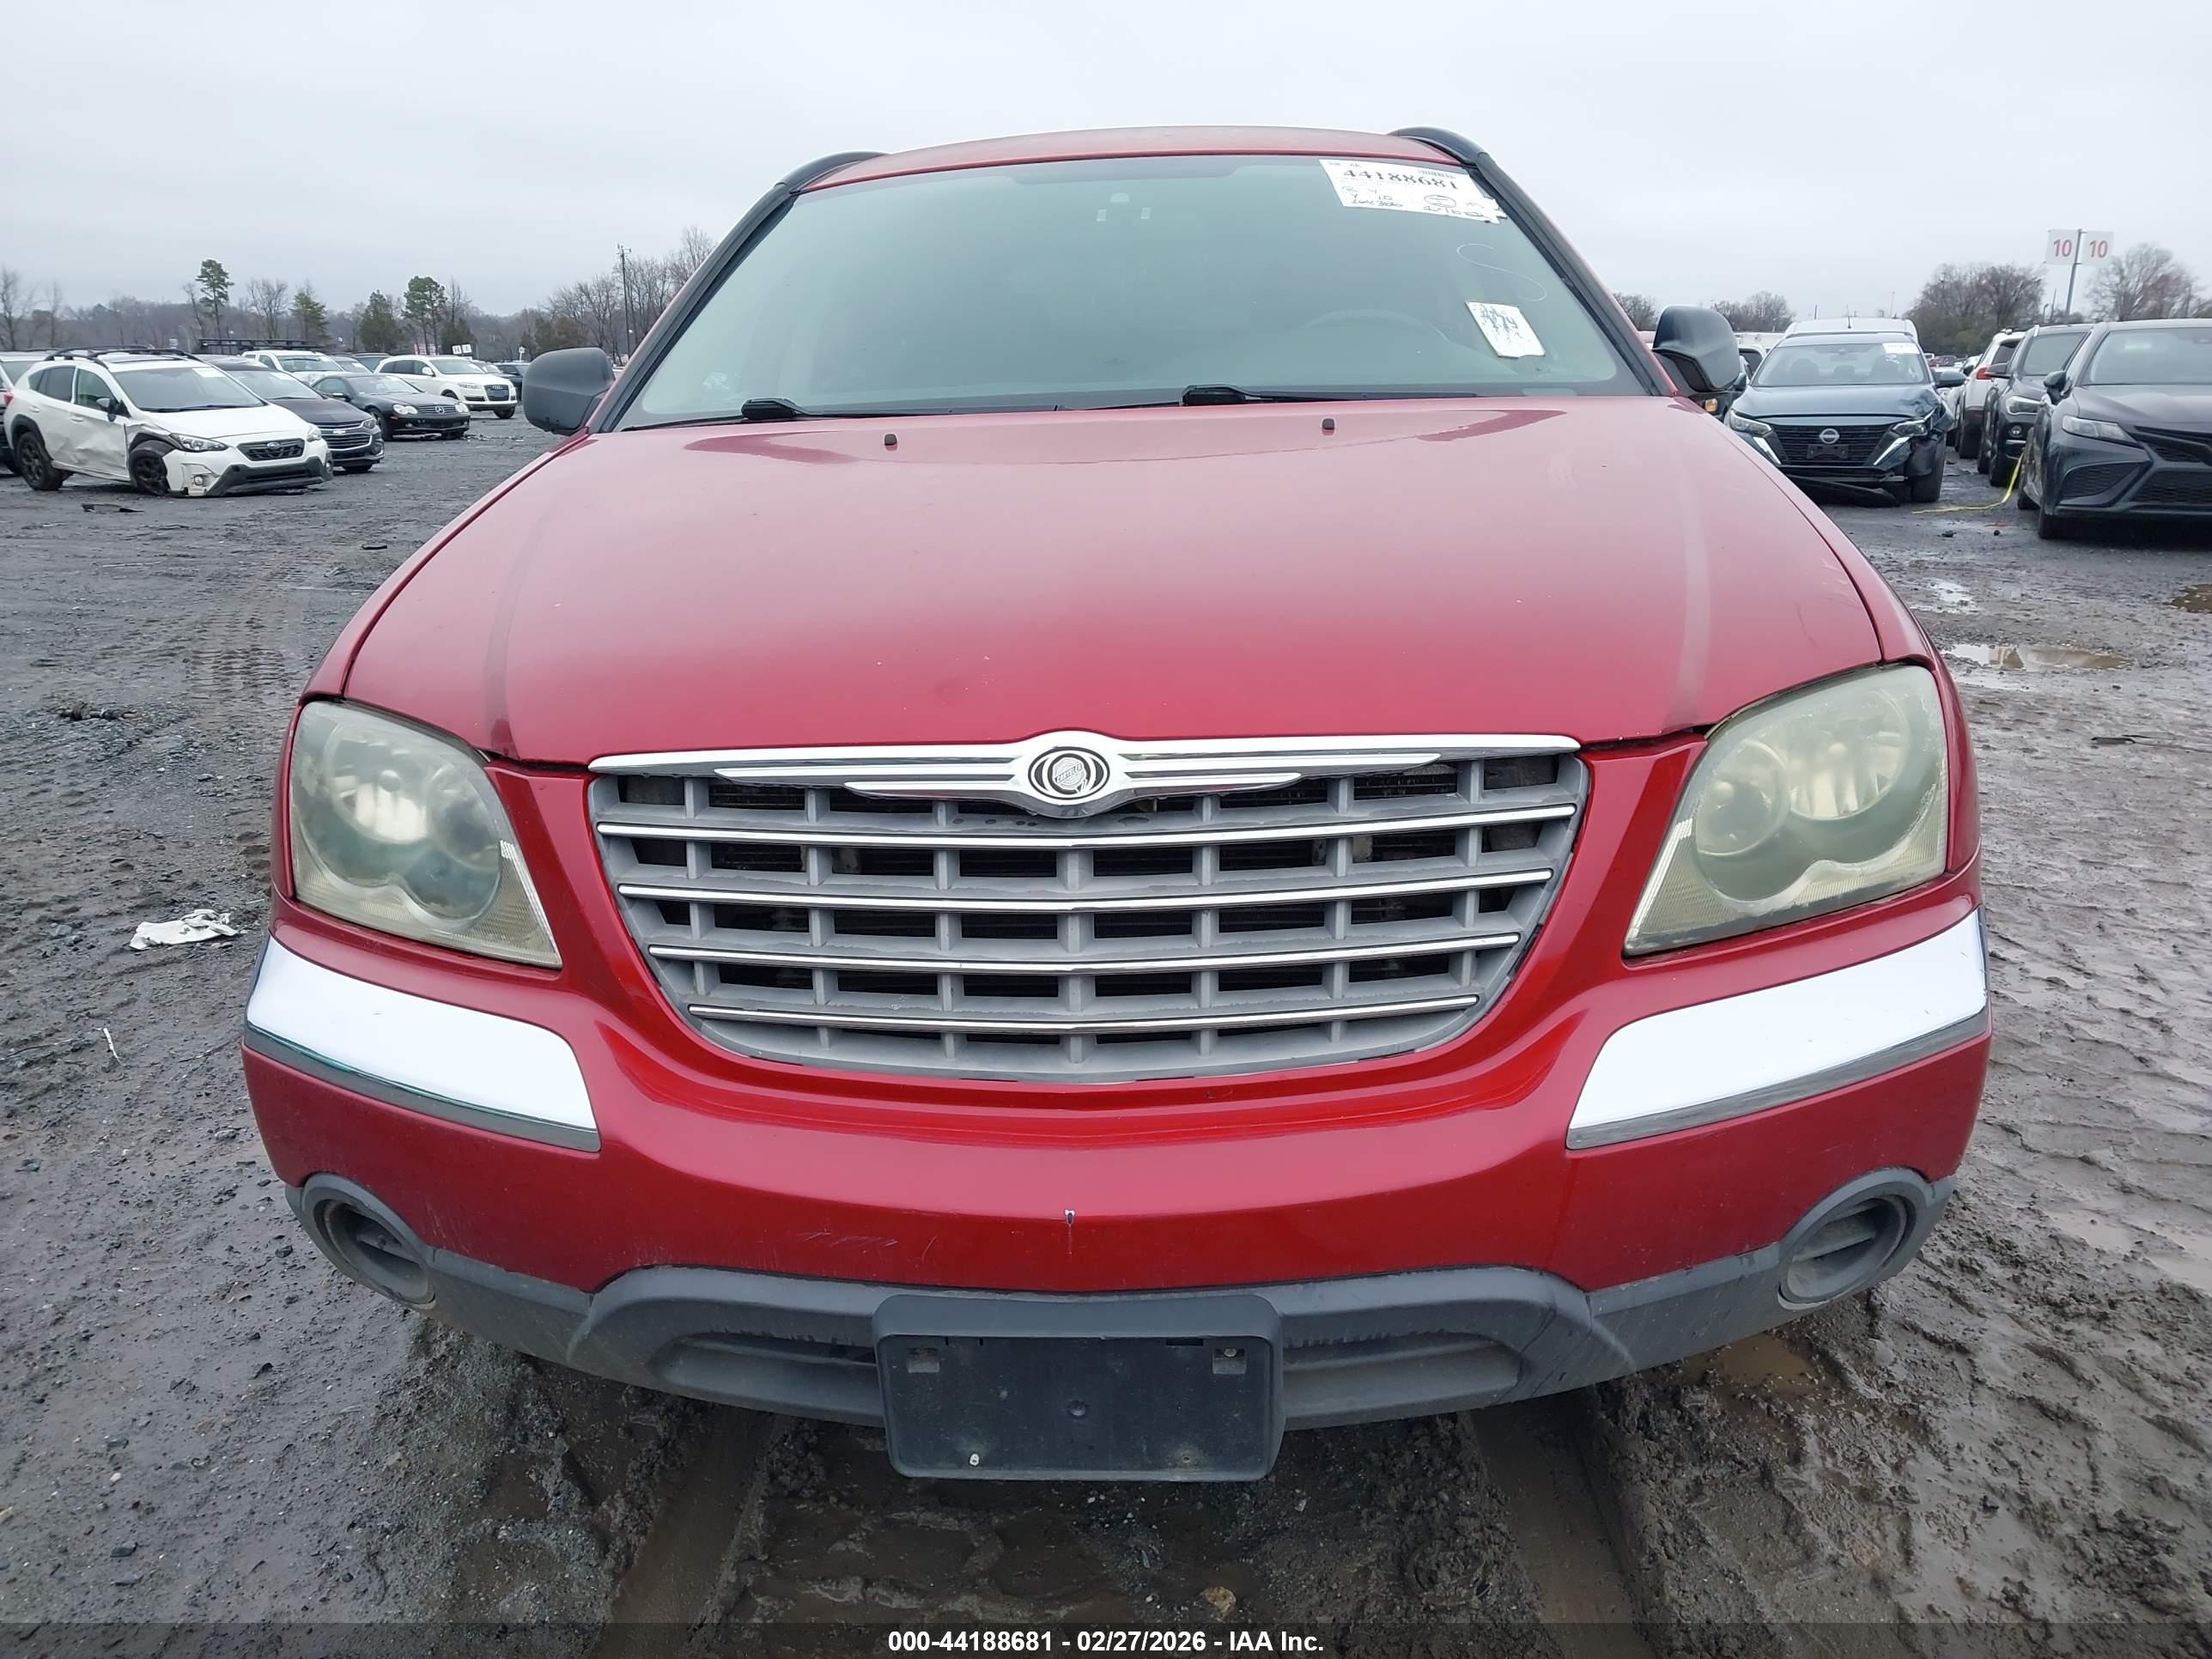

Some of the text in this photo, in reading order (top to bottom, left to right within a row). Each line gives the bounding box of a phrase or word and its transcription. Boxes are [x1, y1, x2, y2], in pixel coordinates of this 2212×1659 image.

[1343, 169, 1458, 190] 44188681
[2053, 239, 2072, 258] 10
[2089, 240, 2108, 258] 10
